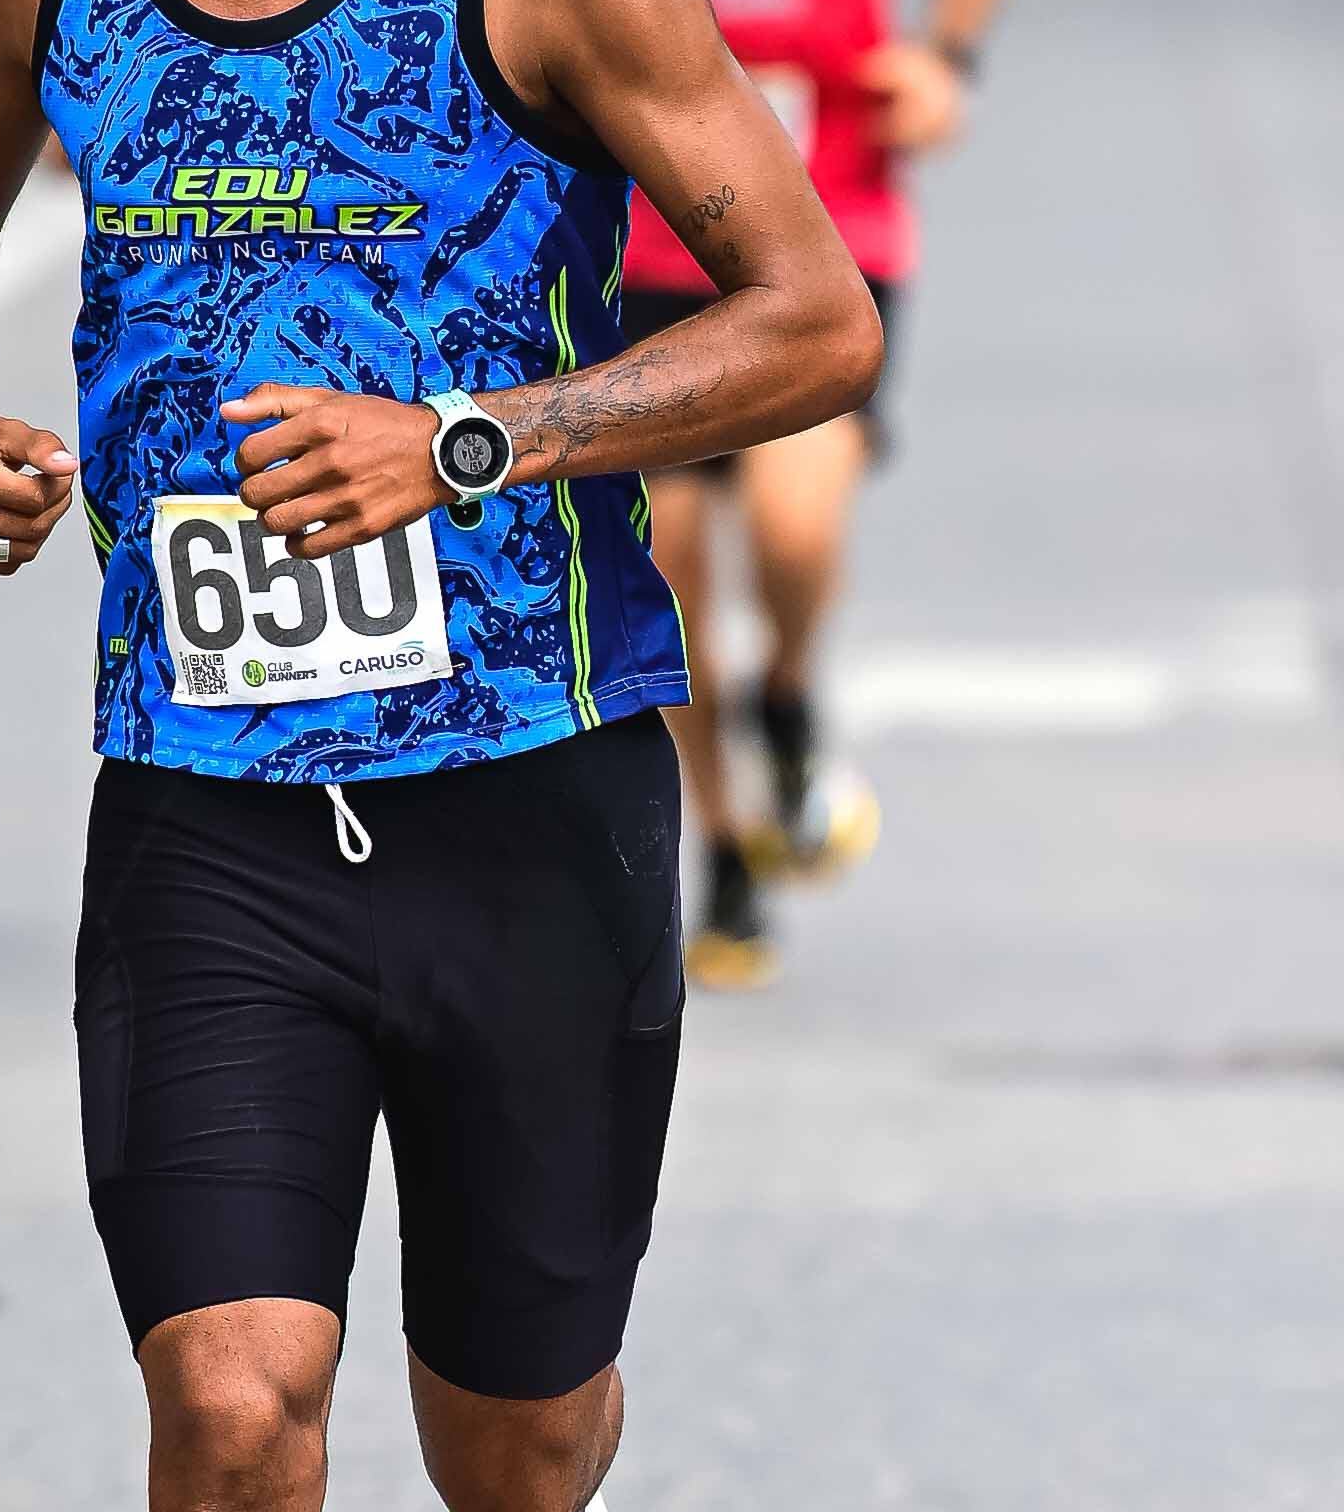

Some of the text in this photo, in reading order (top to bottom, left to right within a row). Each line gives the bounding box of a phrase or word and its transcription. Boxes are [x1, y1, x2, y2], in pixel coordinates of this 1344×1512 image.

[171, 168, 308, 200] EDU
[96, 204, 424, 238] GONZALEZ
[128, 240, 386, 265] RUNNING TEAM
[169, 518, 418, 651] 650
[267, 661, 293, 672] CLUB
[339, 651, 424, 675] CARUSO
